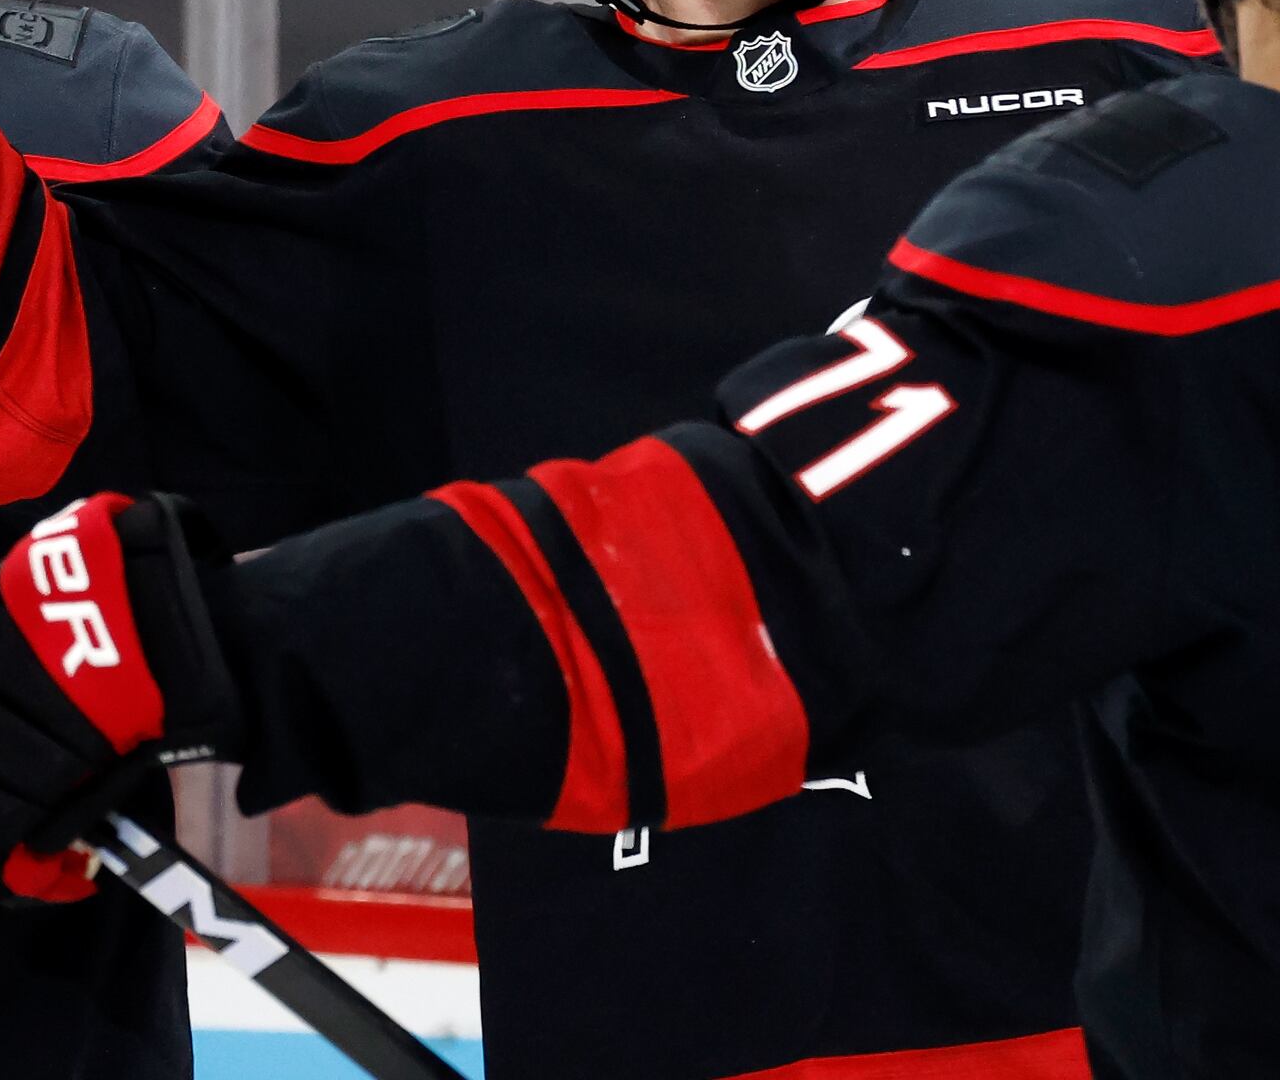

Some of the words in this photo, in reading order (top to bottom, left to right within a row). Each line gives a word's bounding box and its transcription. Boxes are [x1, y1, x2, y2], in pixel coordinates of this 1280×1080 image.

[751, 48, 782, 83] NHL
[927, 88, 1085, 118] NUCOR
[734, 316, 961, 504] 71
[28, 497, 121, 679] UER
